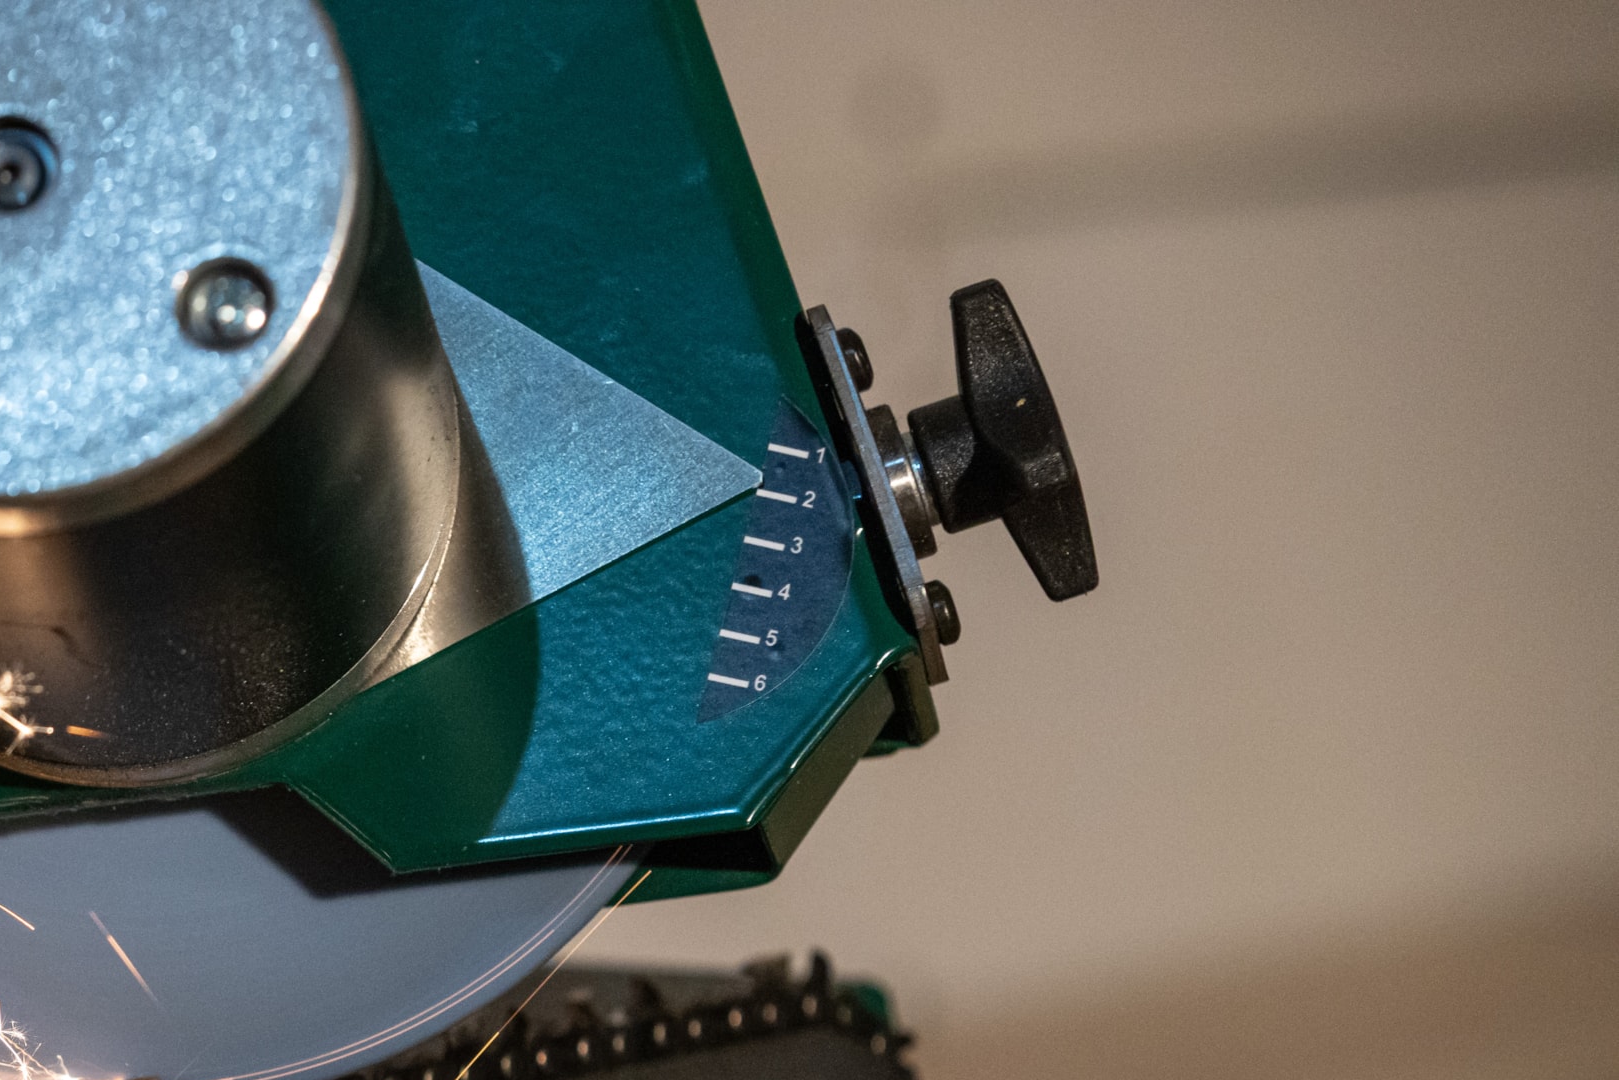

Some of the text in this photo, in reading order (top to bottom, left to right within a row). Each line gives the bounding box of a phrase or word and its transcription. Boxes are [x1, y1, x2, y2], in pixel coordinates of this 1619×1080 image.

[816, 446, 827, 465] 1
[802, 490, 817, 510] 2
[790, 536, 804, 555] 3
[777, 583, 792, 602] 4
[764, 629, 779, 648] 5
[753, 674, 767, 693] 6
